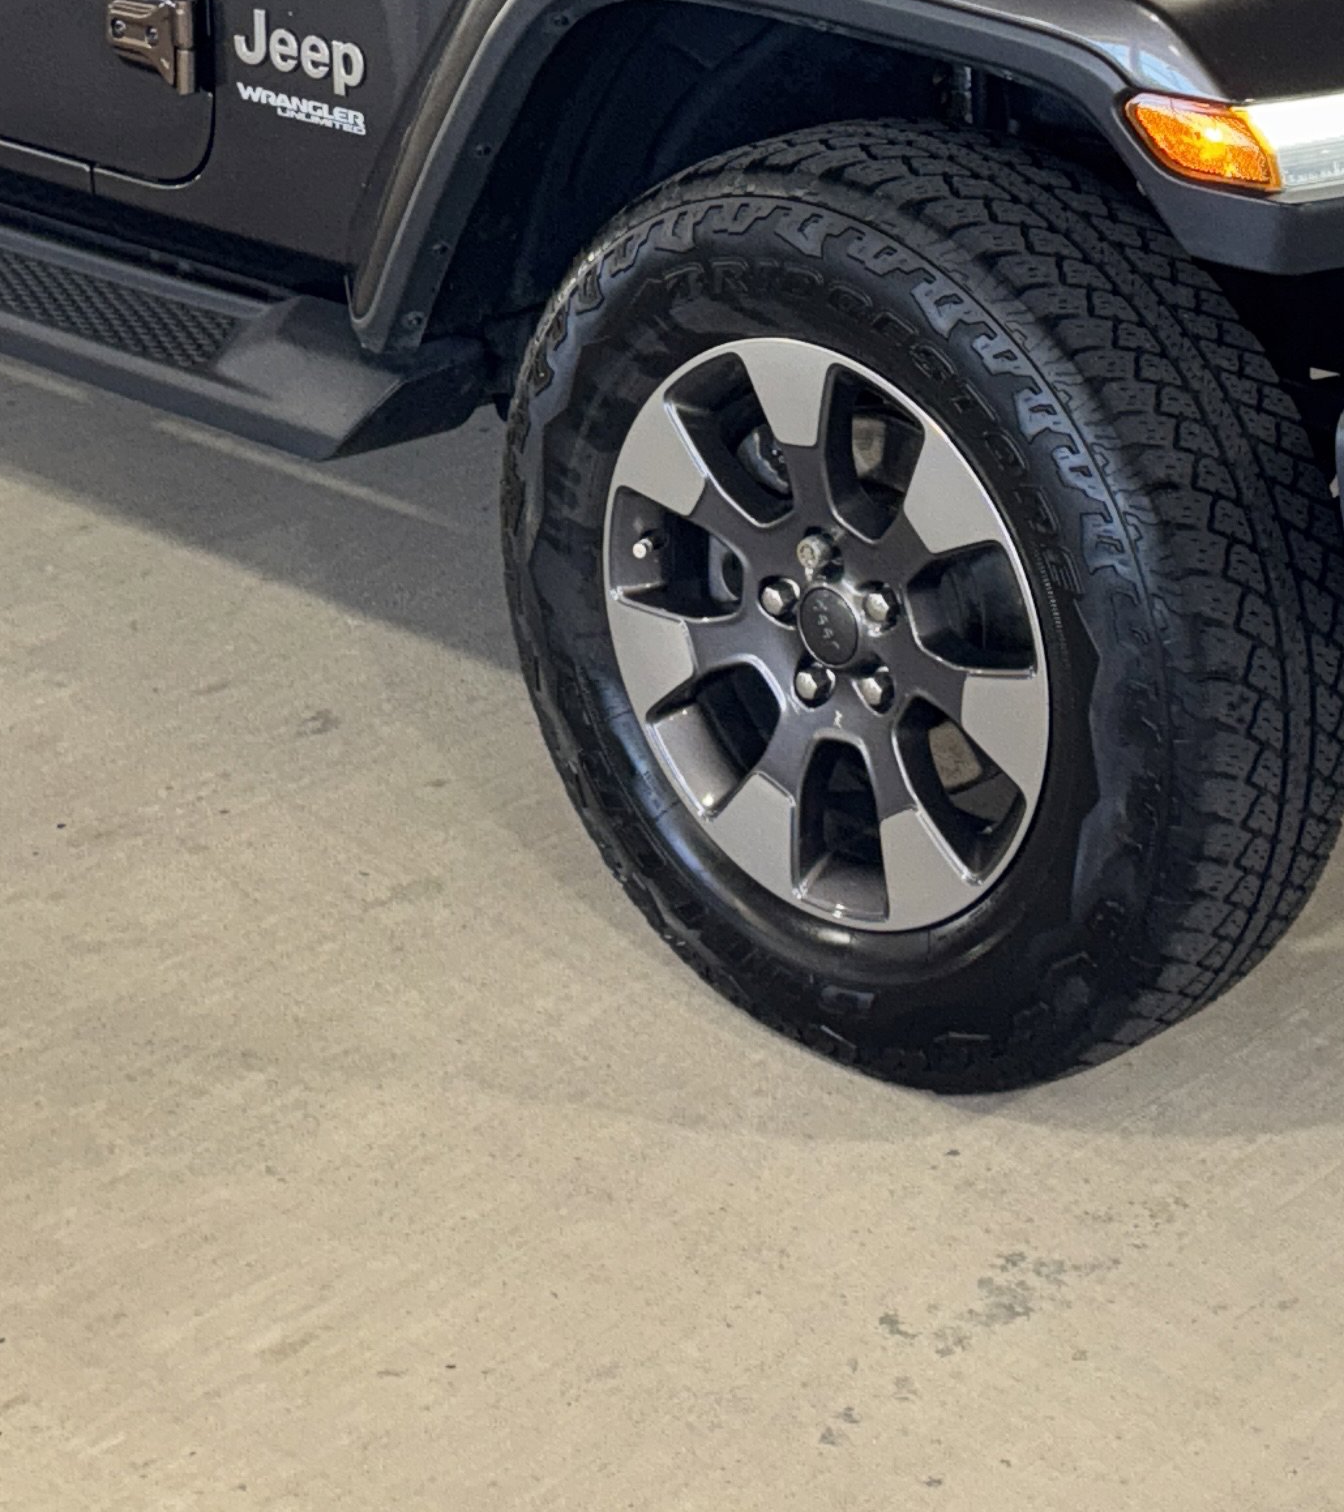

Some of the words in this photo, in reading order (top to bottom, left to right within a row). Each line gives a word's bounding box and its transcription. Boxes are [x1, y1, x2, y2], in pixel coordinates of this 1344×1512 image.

[233, 8, 366, 96] Jeep
[236, 81, 365, 126] WRANGLER
[276, 106, 367, 136] UNLIMITED
